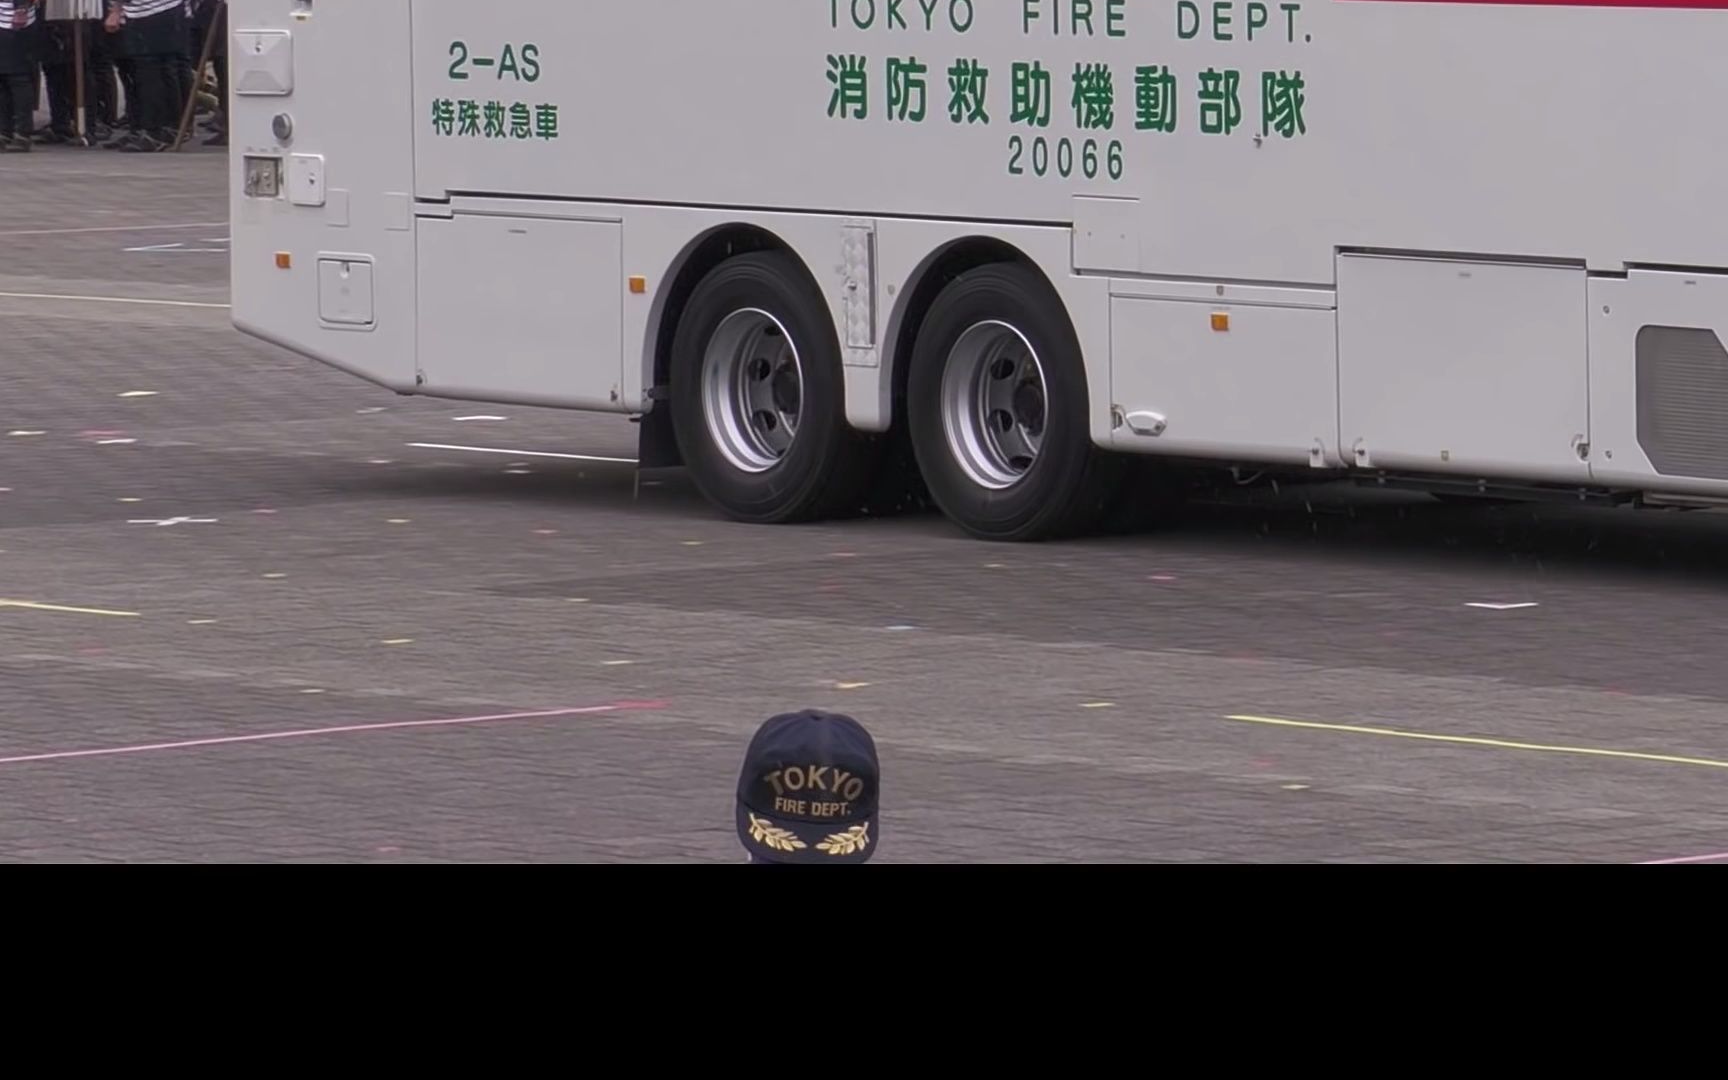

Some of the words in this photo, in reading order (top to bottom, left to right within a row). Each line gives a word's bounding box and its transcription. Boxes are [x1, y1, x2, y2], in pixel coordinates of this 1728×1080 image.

[1176, 0, 1312, 44] DEPT.
[448, 40, 541, 83] 2-AS
[825, 53, 1307, 139] 消防救助機動部隊
[431, 98, 559, 141] 特殊救急車
[1008, 135, 1124, 180] 20066
[763, 764, 865, 801] TOKYO
[774, 796, 807, 816] FIRE
[811, 801, 853, 817] DEPT.
